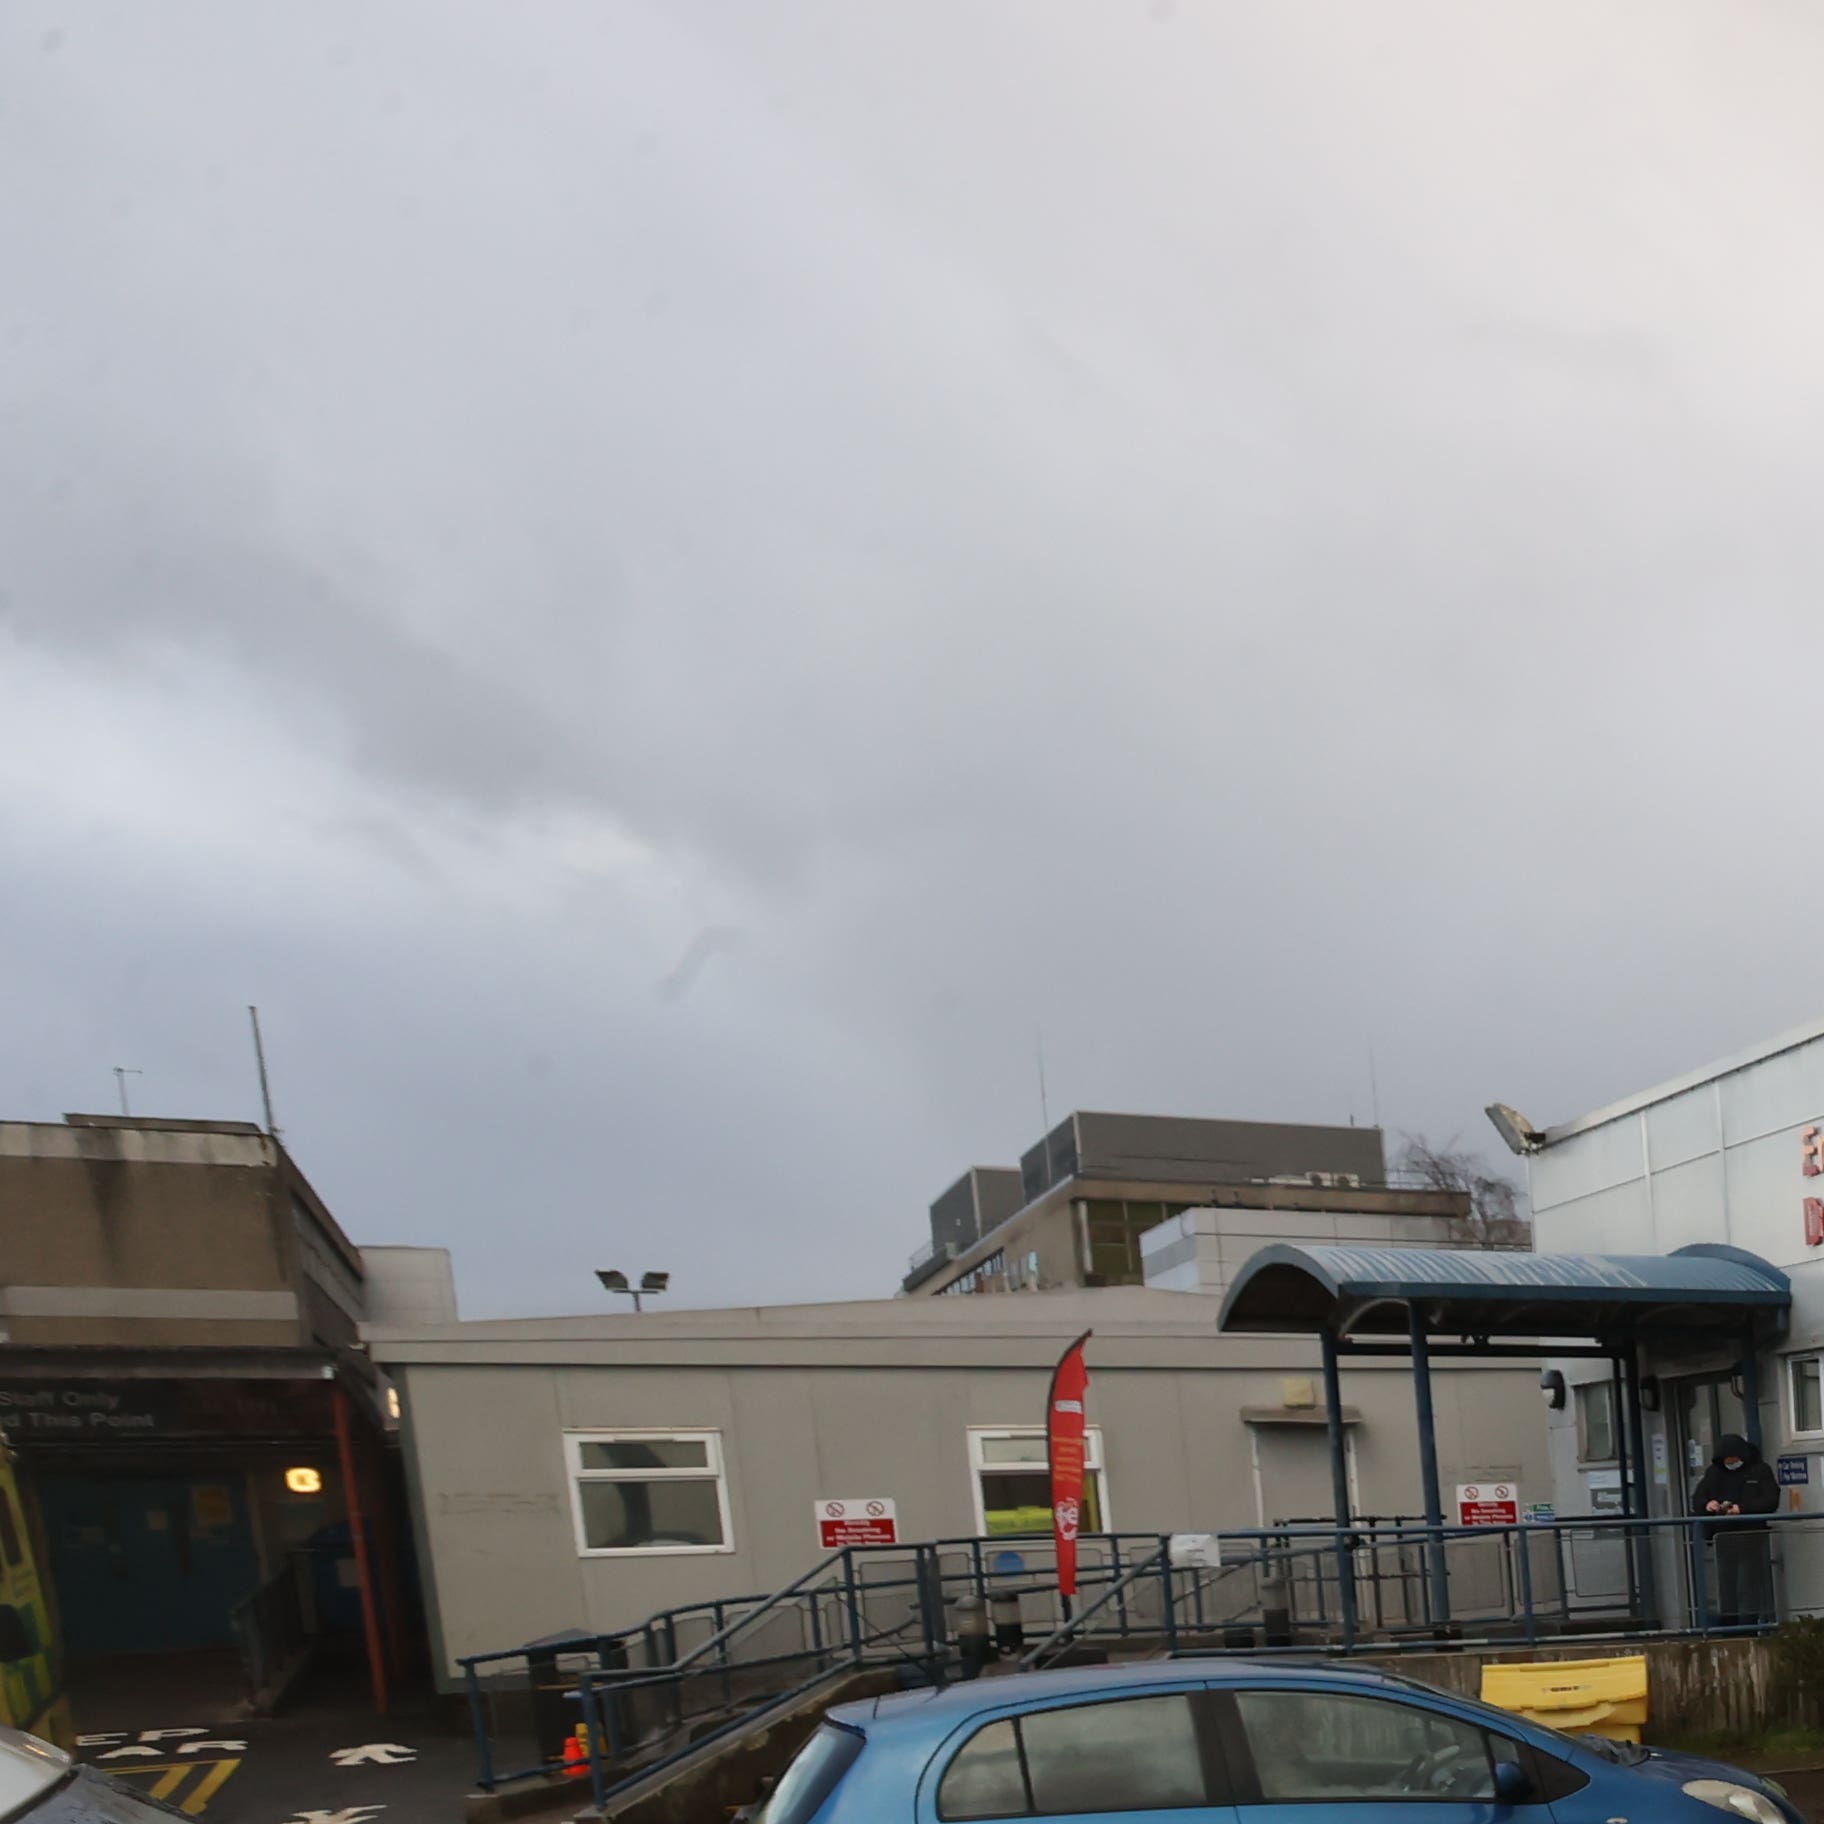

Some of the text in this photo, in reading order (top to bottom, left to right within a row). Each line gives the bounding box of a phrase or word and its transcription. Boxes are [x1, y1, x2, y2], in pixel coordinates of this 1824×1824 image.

[62, 1391, 120, 1409] Only
[28, 1411, 82, 1428] This
[89, 1412, 154, 1428] Point
[75, 1727, 210, 1746] EP
